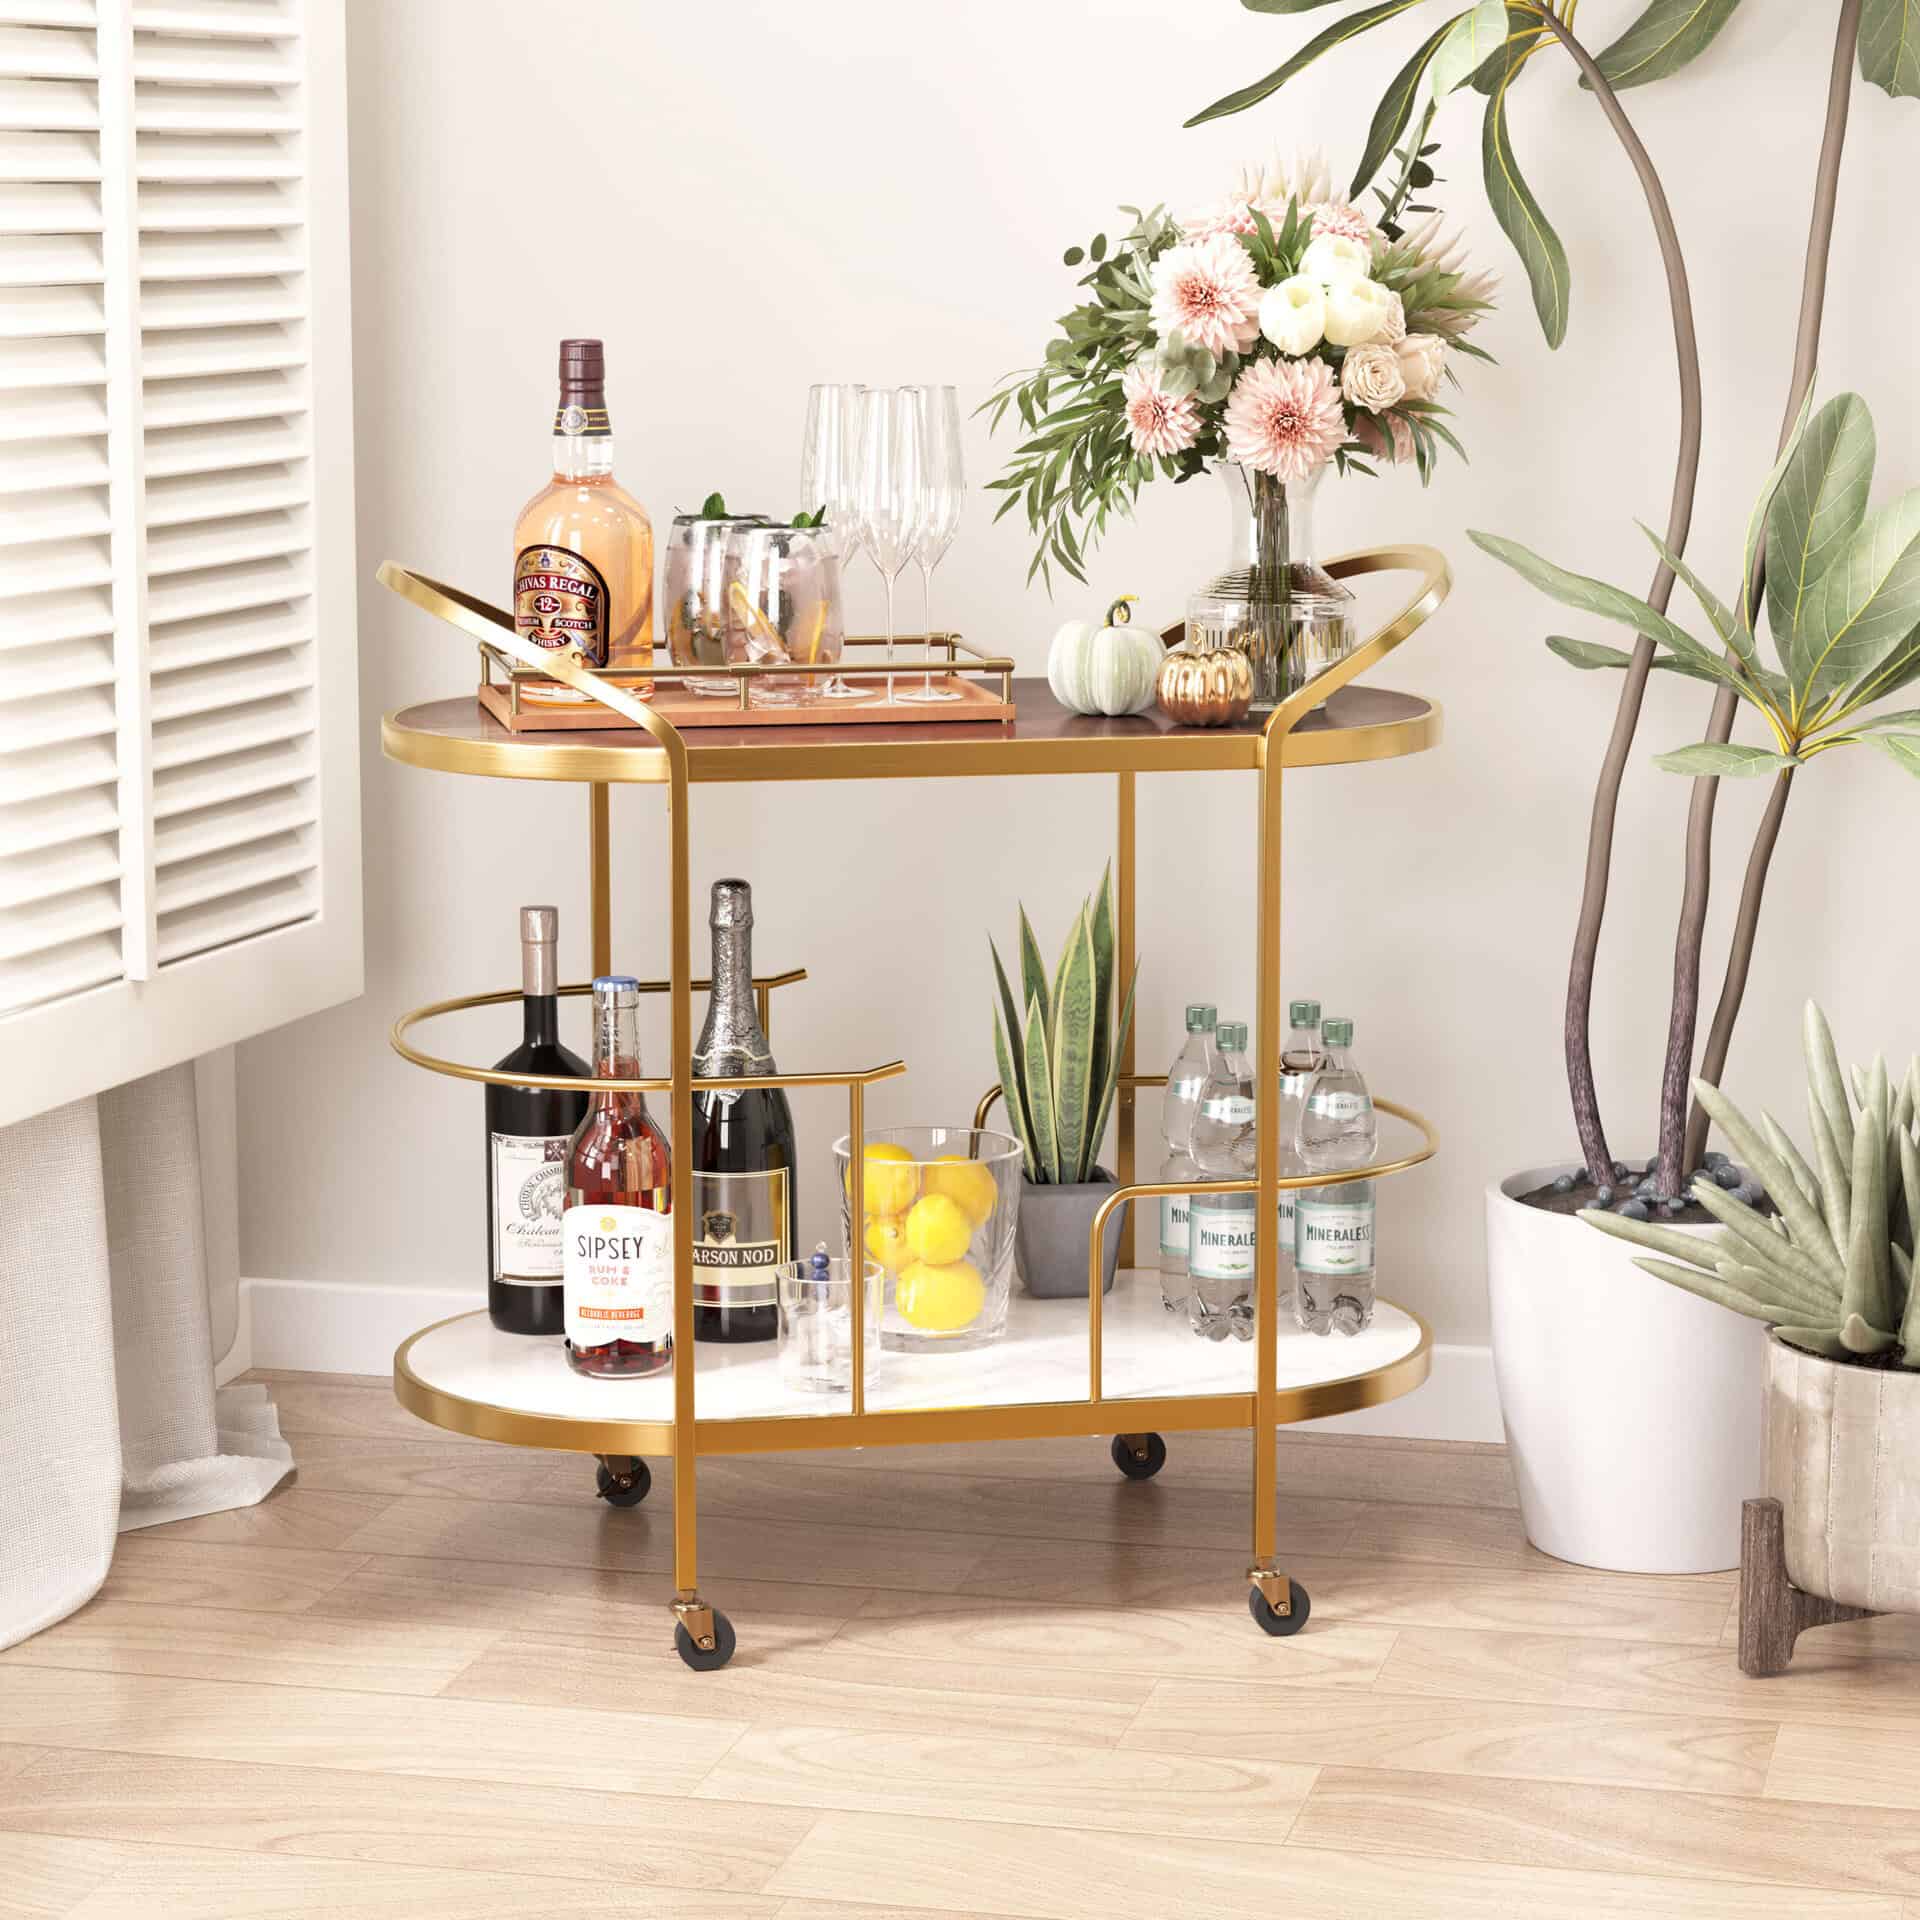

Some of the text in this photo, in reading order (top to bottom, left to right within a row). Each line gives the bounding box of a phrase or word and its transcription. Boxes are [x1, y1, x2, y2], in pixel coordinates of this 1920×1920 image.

[549, 577, 595, 598] REGAL
[539, 596, 553, 611] 12
[554, 620, 592, 629] SCOTCH
[530, 634, 566, 647] WHISKY
[1306, 1223, 1369, 1241] MINERALESS
[577, 1234, 643, 1260] SIPSEY
[742, 1248, 775, 1264] NOD
[588, 1264, 617, 1274] RUM
[591, 1276, 628, 1286] COKE
[611, 1309, 640, 1319] BEVERAGE
